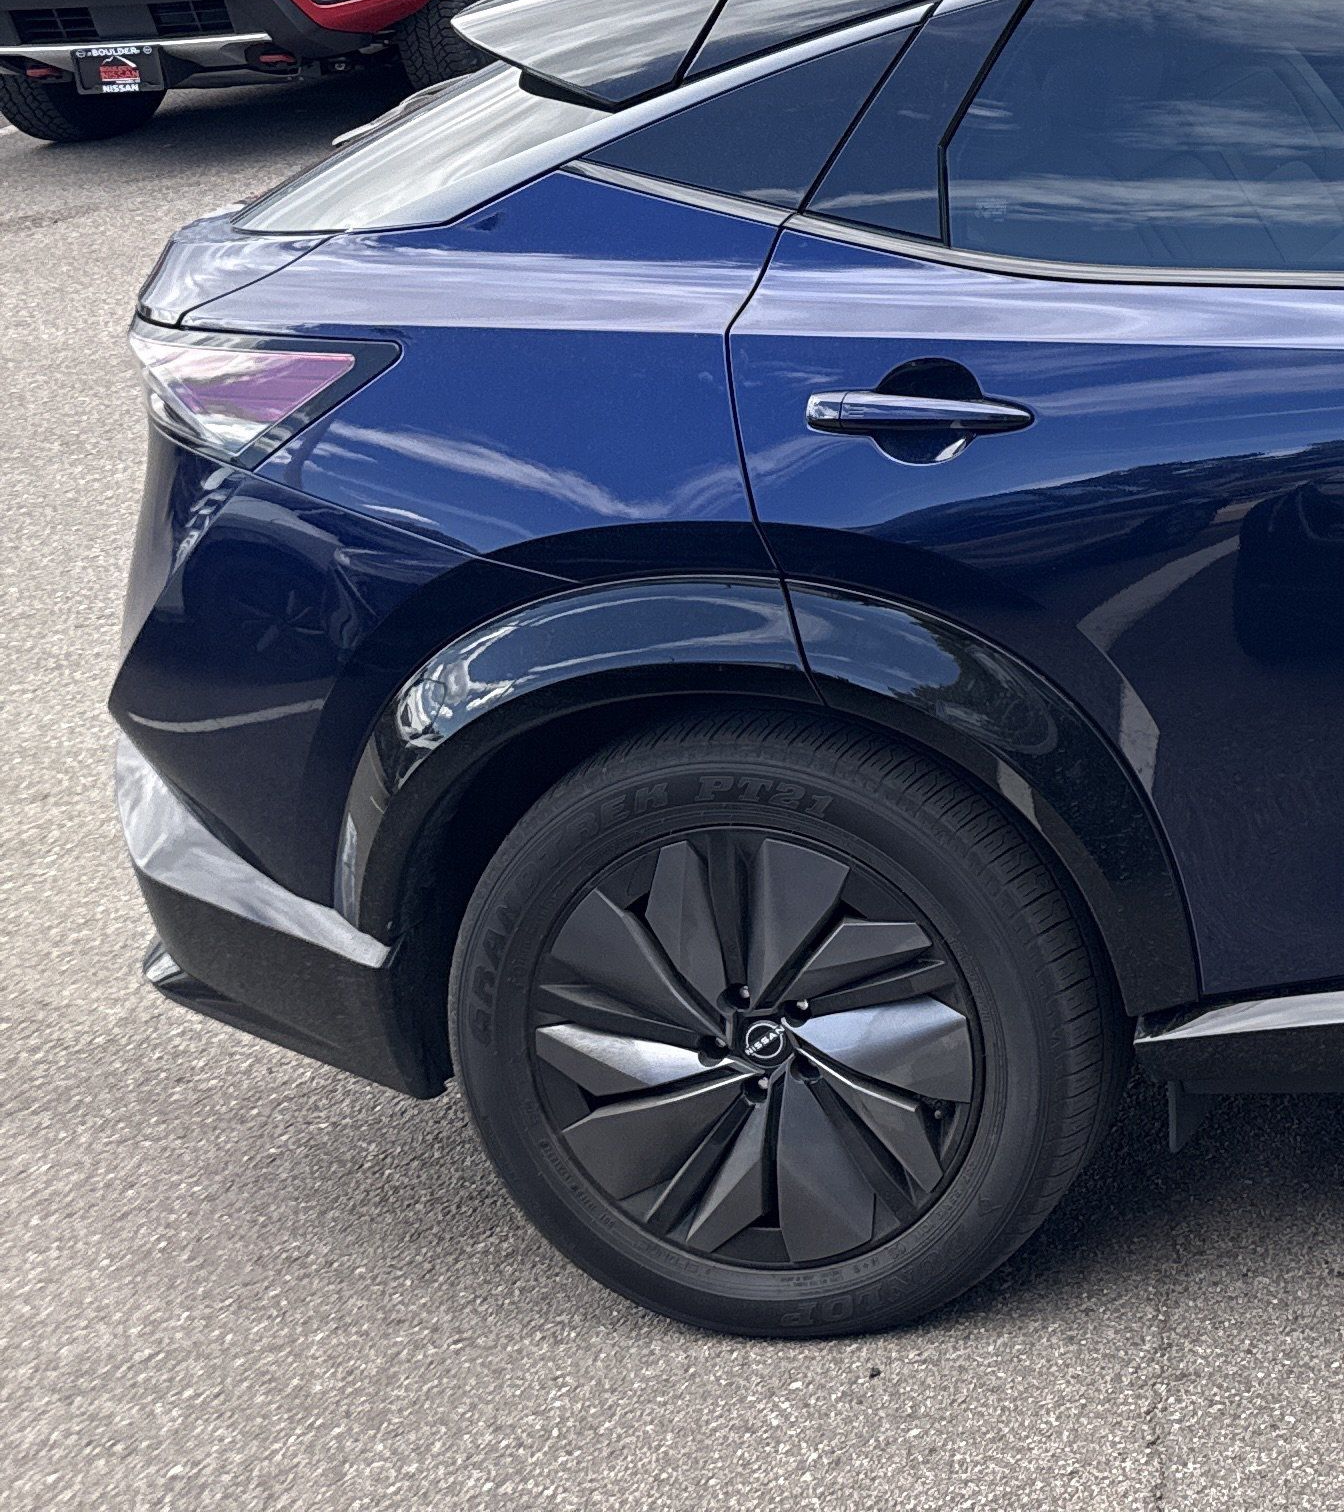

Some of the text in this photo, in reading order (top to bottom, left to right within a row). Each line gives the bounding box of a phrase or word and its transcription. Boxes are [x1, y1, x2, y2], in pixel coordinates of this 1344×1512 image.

[91, 47, 138, 56] BOULDER
[102, 84, 138, 93] NISSAN
[694, 775, 835, 819] PT21
[745, 1025, 785, 1056] NISSAN
